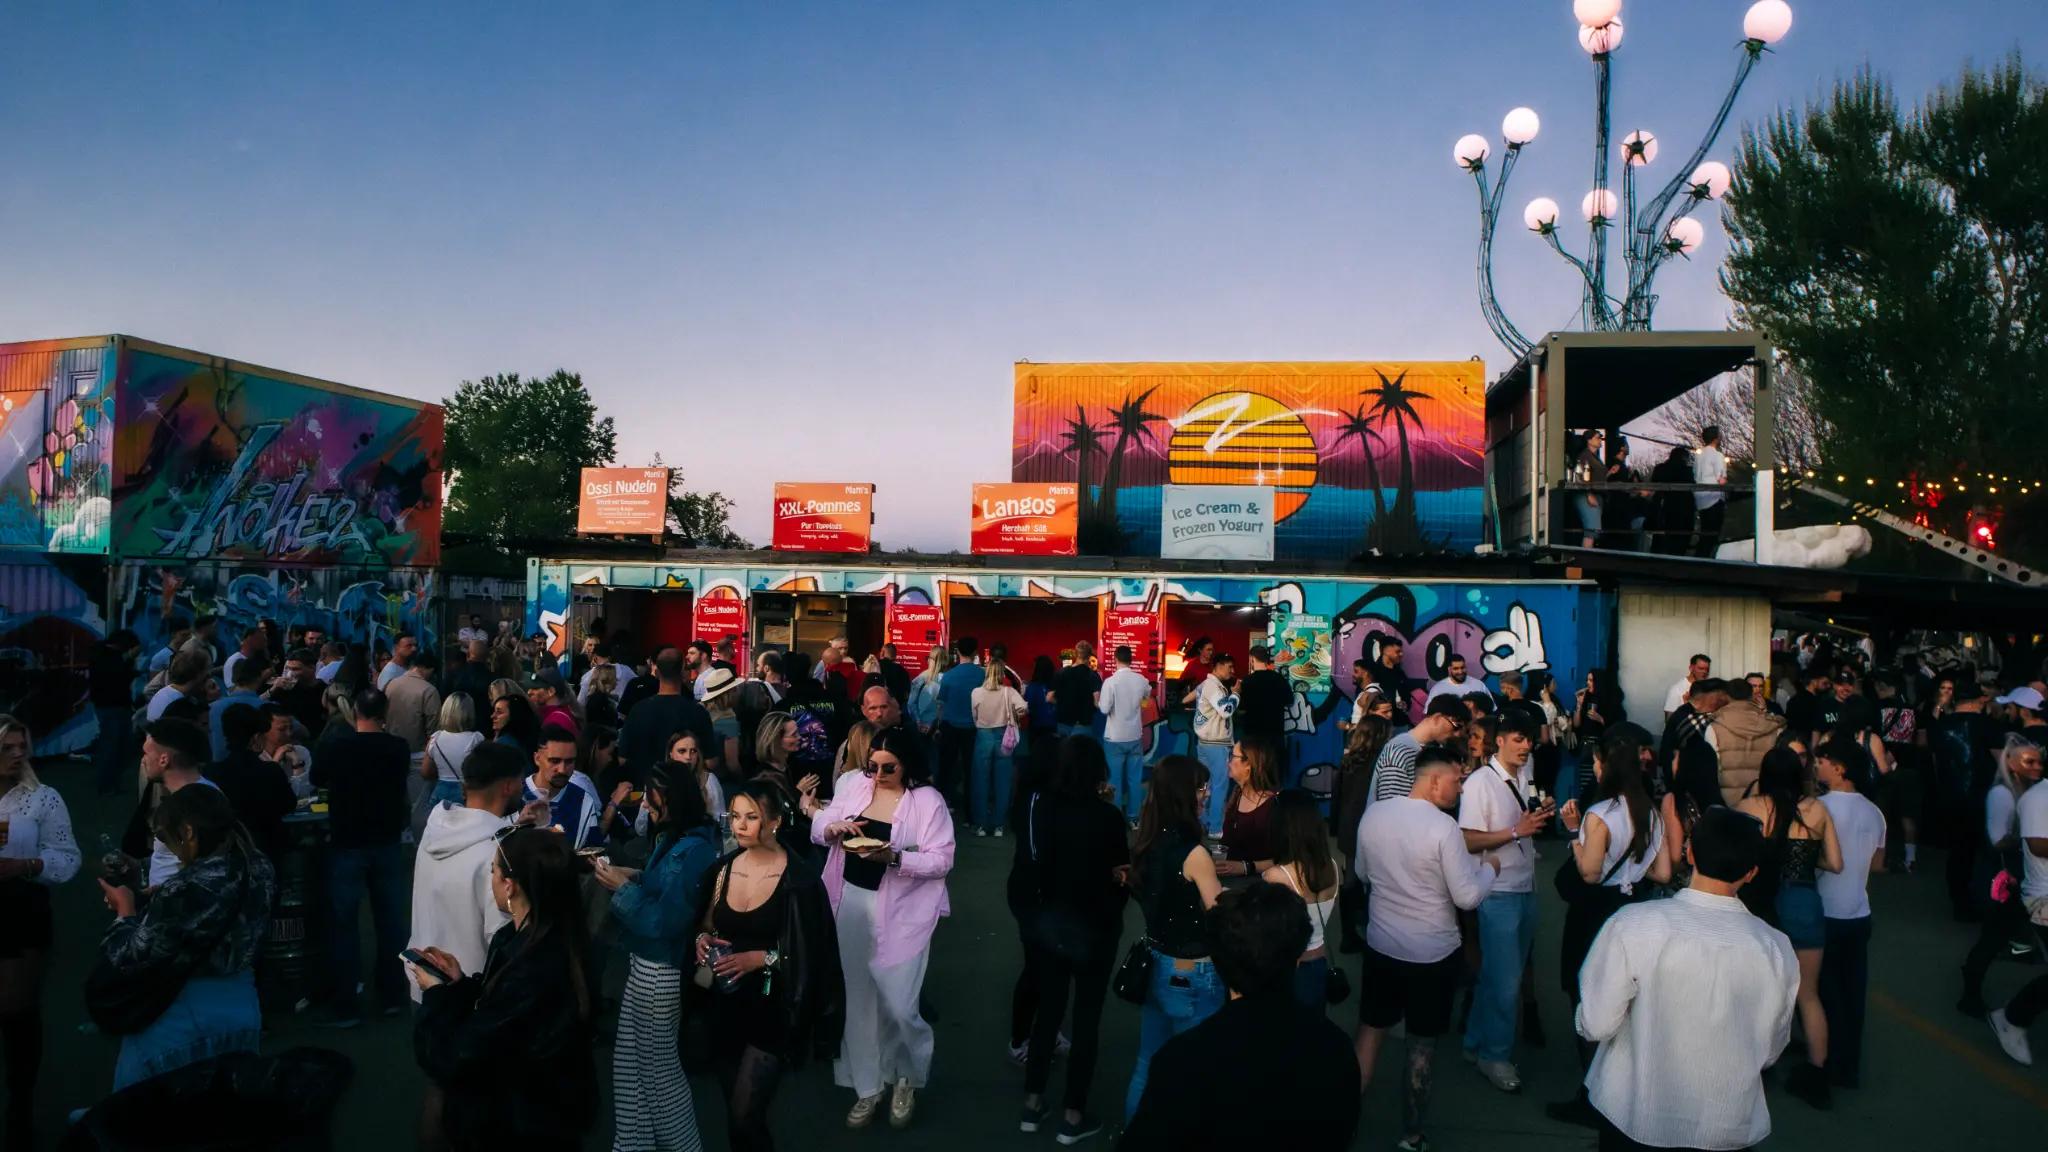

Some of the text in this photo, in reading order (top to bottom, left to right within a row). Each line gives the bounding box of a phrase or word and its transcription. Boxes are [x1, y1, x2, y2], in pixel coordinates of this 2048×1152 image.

[586, 480, 657, 495] Ossi Nudeln
[779, 500, 861, 516] XXL-Pommes
[982, 496, 1057, 520] Langos
[1172, 502, 1260, 520] Ice Cream &
[1001, 524, 1030, 533] Herzhaft
[1172, 519, 1264, 538] Frozen Yogurt
[1118, 616, 1150, 625] Langos
